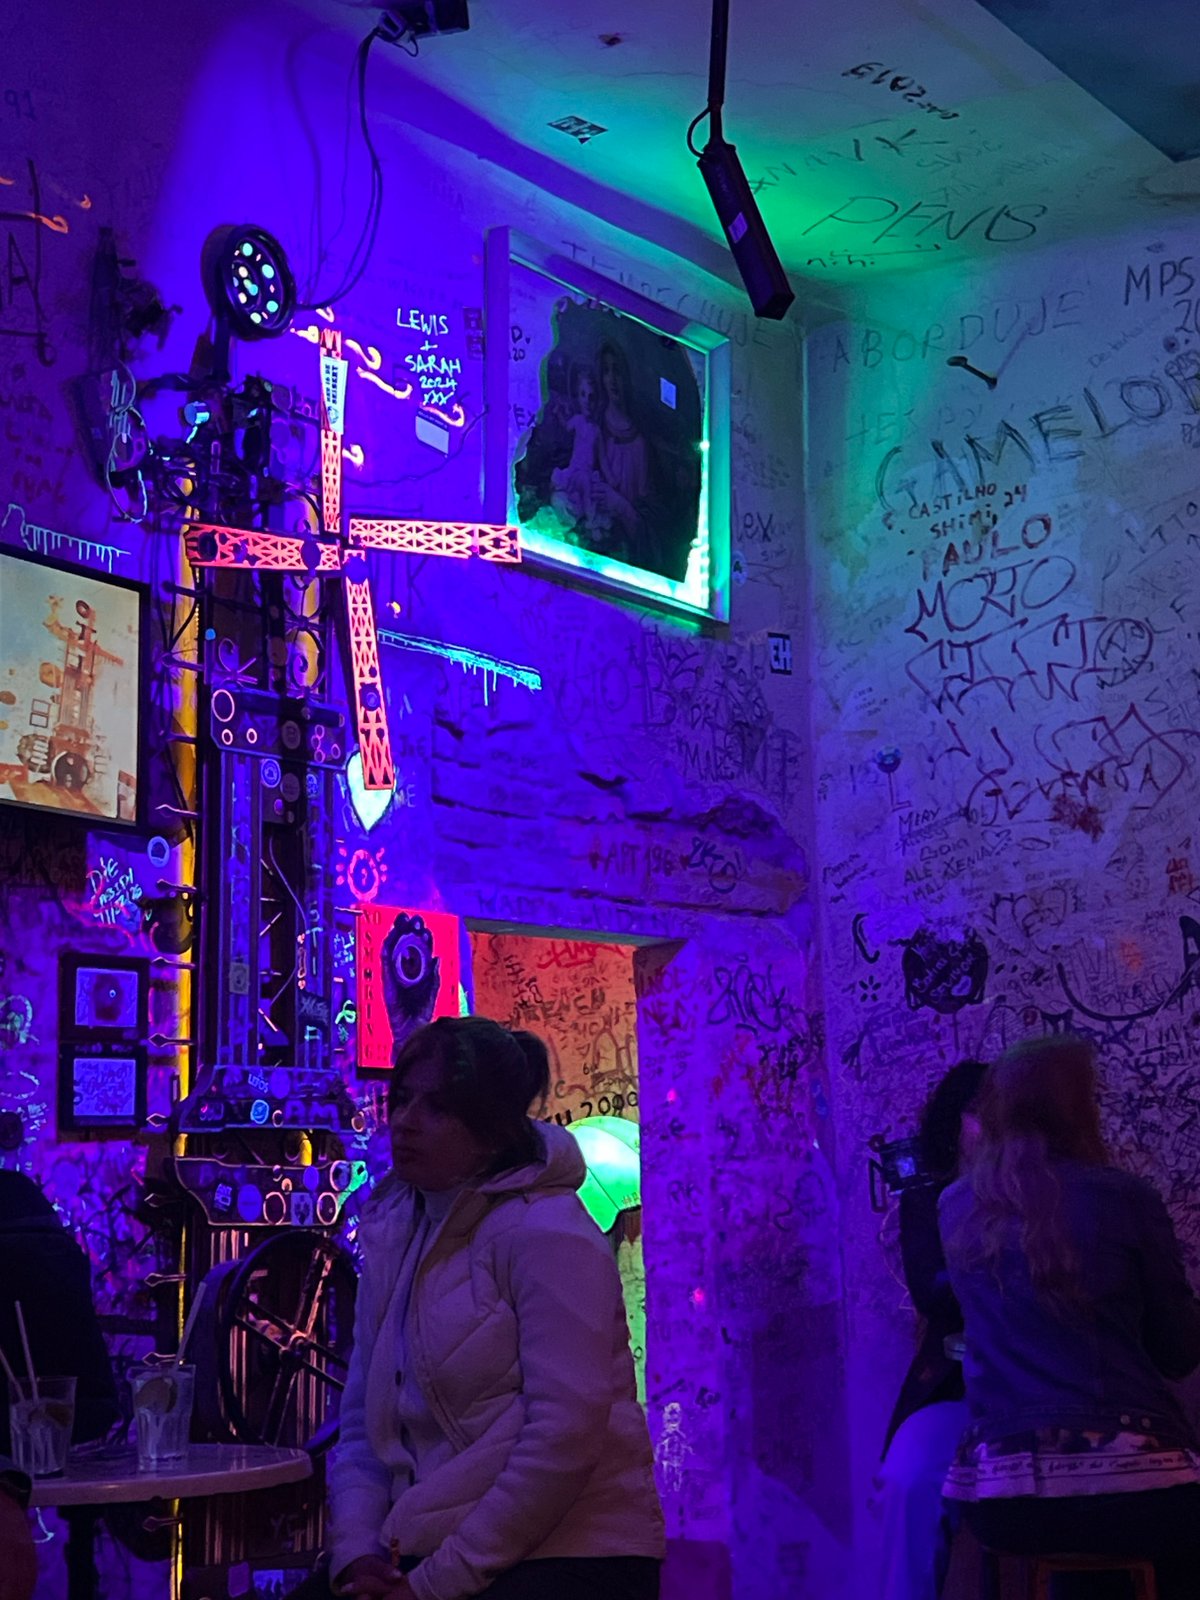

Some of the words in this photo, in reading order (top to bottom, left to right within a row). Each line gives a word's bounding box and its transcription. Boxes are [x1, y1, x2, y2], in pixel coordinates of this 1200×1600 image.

[1124, 256, 1195, 306] MPS
[396, 307, 449, 336] LEWIS
[404, 354, 461, 376] SARAH
